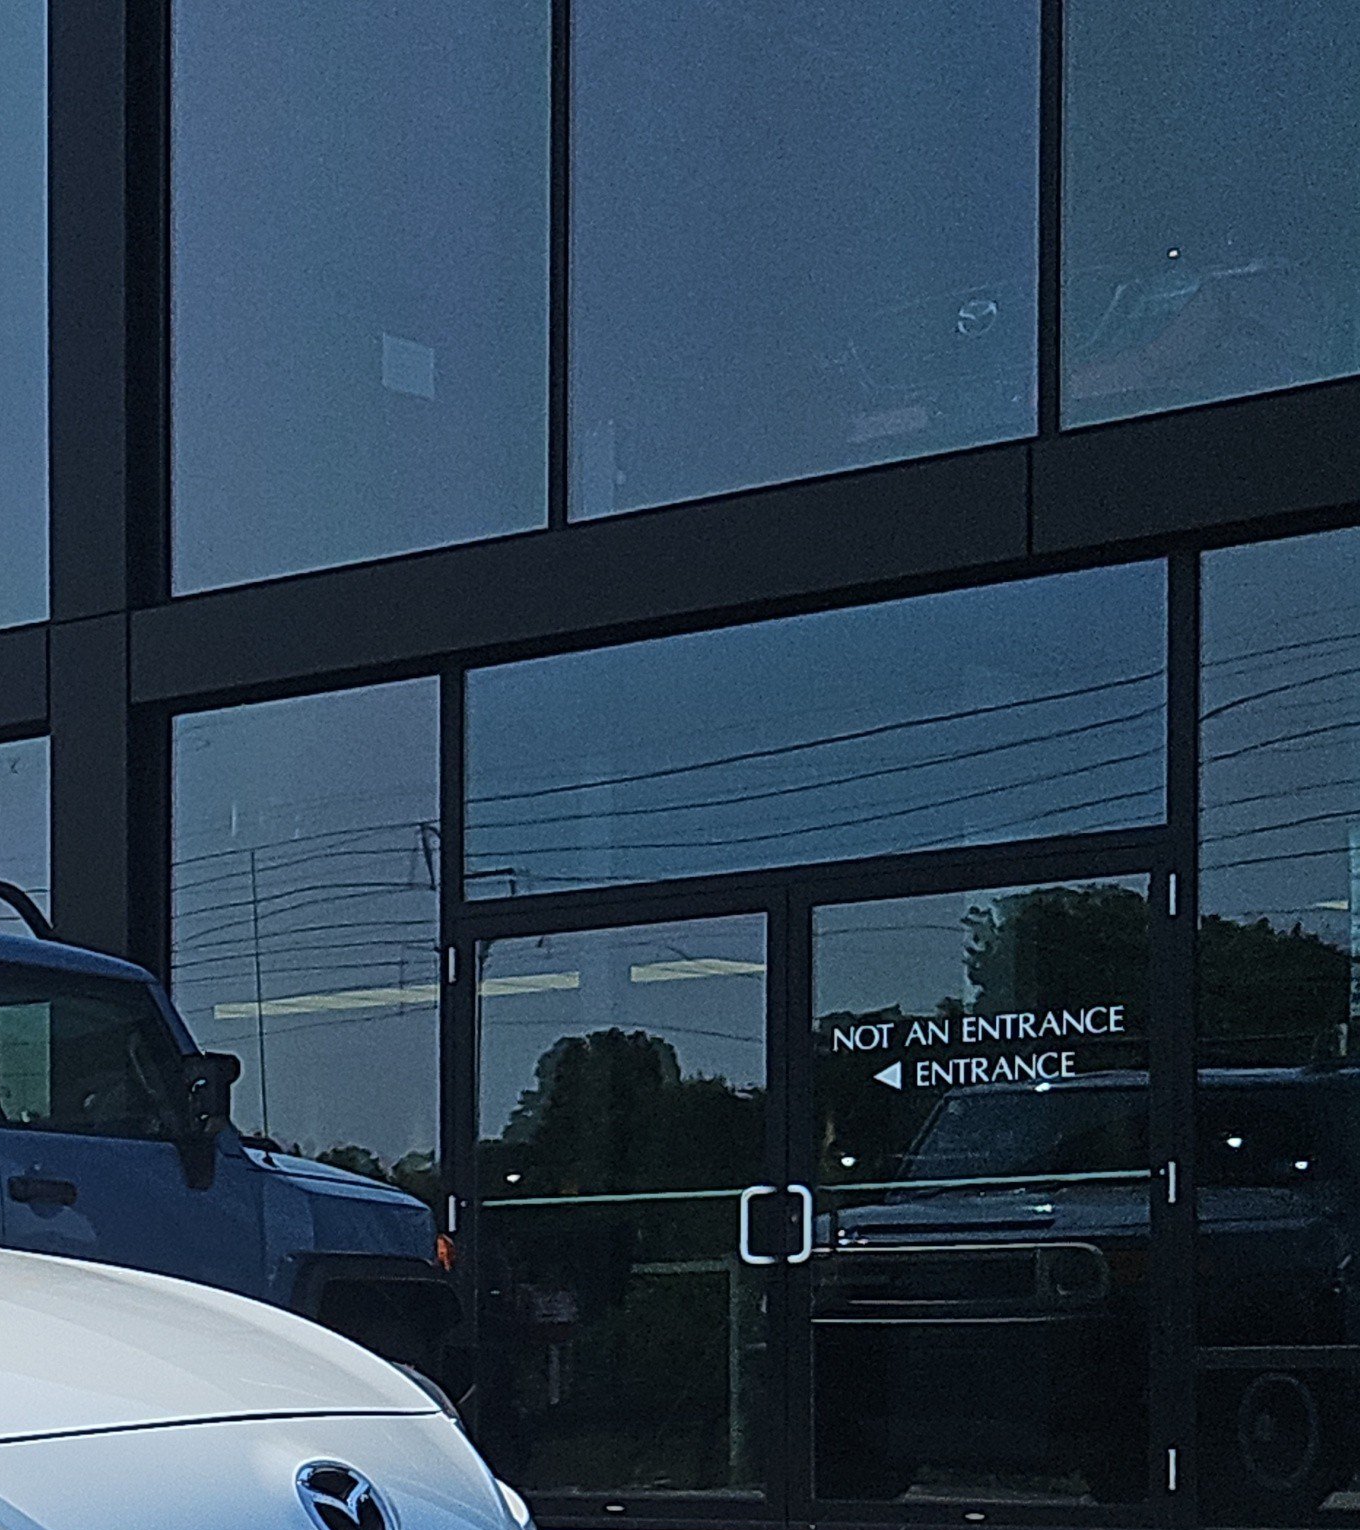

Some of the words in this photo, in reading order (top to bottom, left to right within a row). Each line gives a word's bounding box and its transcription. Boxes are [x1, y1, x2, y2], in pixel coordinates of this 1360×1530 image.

[833, 1022, 894, 1052] NOT
[904, 1020, 949, 1047] AN
[962, 1005, 1125, 1043] ENTRANCE
[916, 1051, 1076, 1087] ENTRANCE
